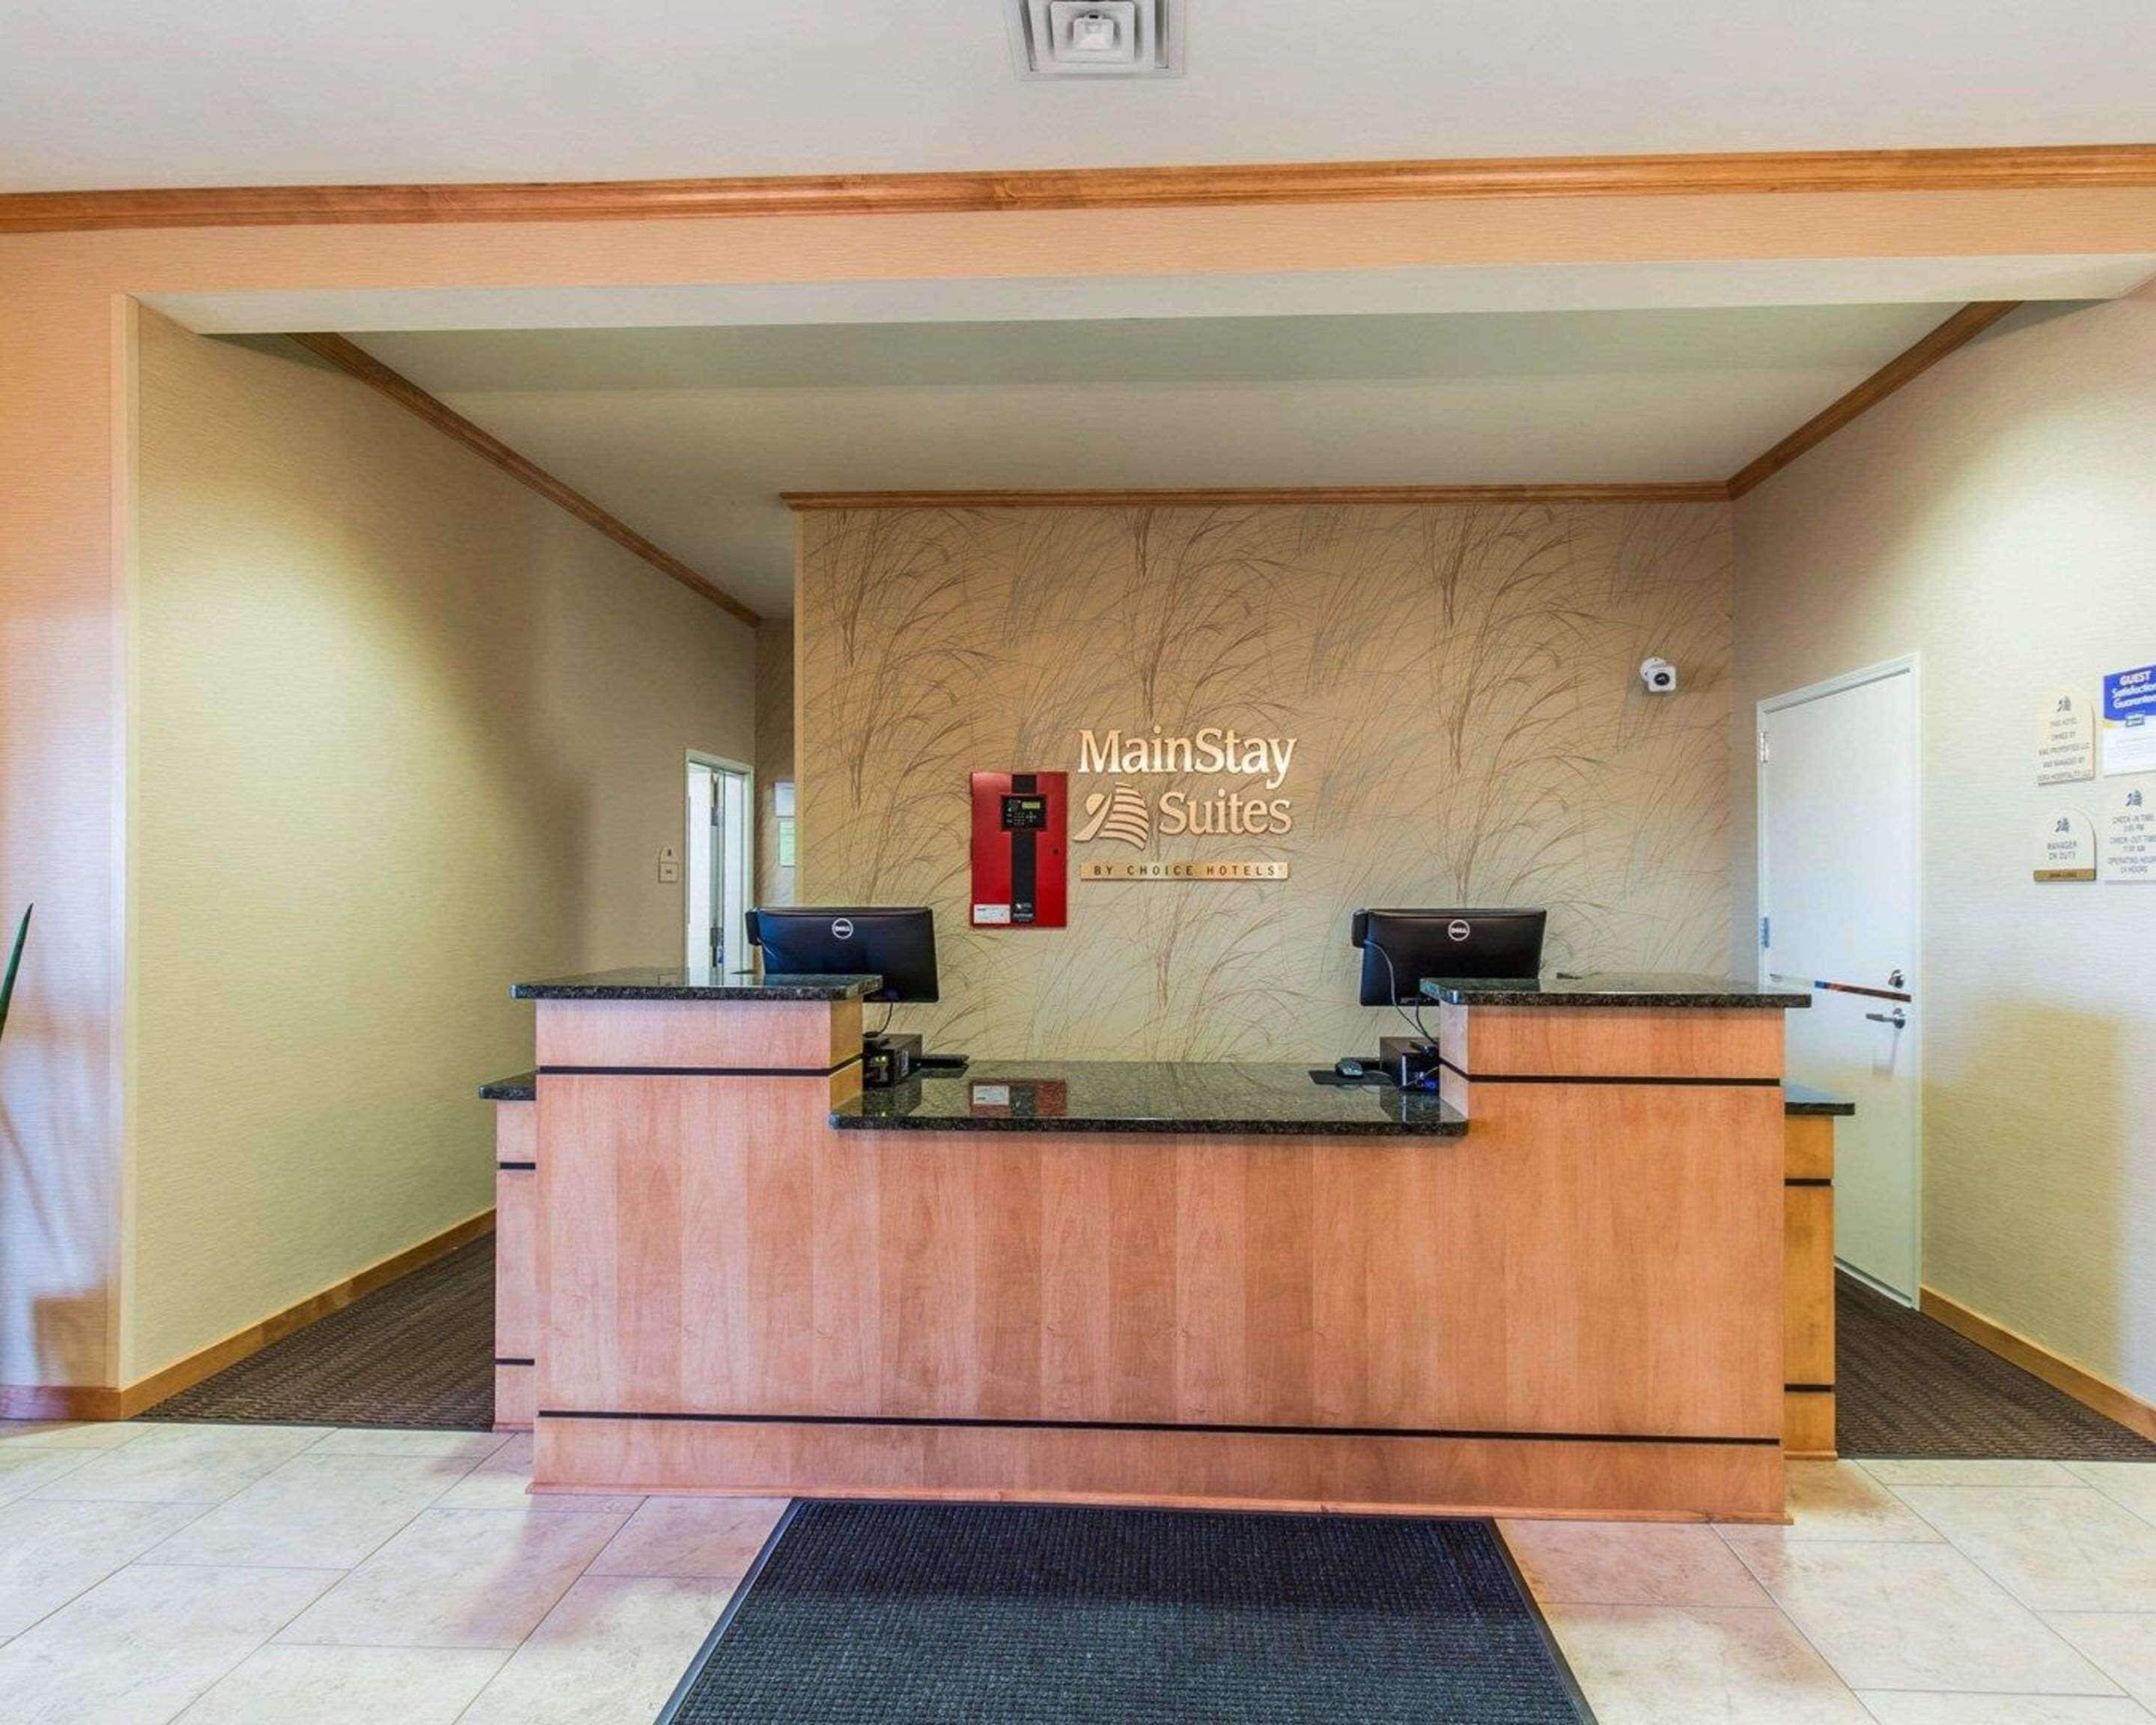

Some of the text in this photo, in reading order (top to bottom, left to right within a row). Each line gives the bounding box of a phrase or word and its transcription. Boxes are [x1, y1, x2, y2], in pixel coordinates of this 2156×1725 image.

[2119, 670, 2152, 687] GUEST
[1078, 725, 1297, 790] MainStay
[1160, 788, 1292, 835] Suites
[1094, 865, 1275, 876] BY CHOICE HOTELS
